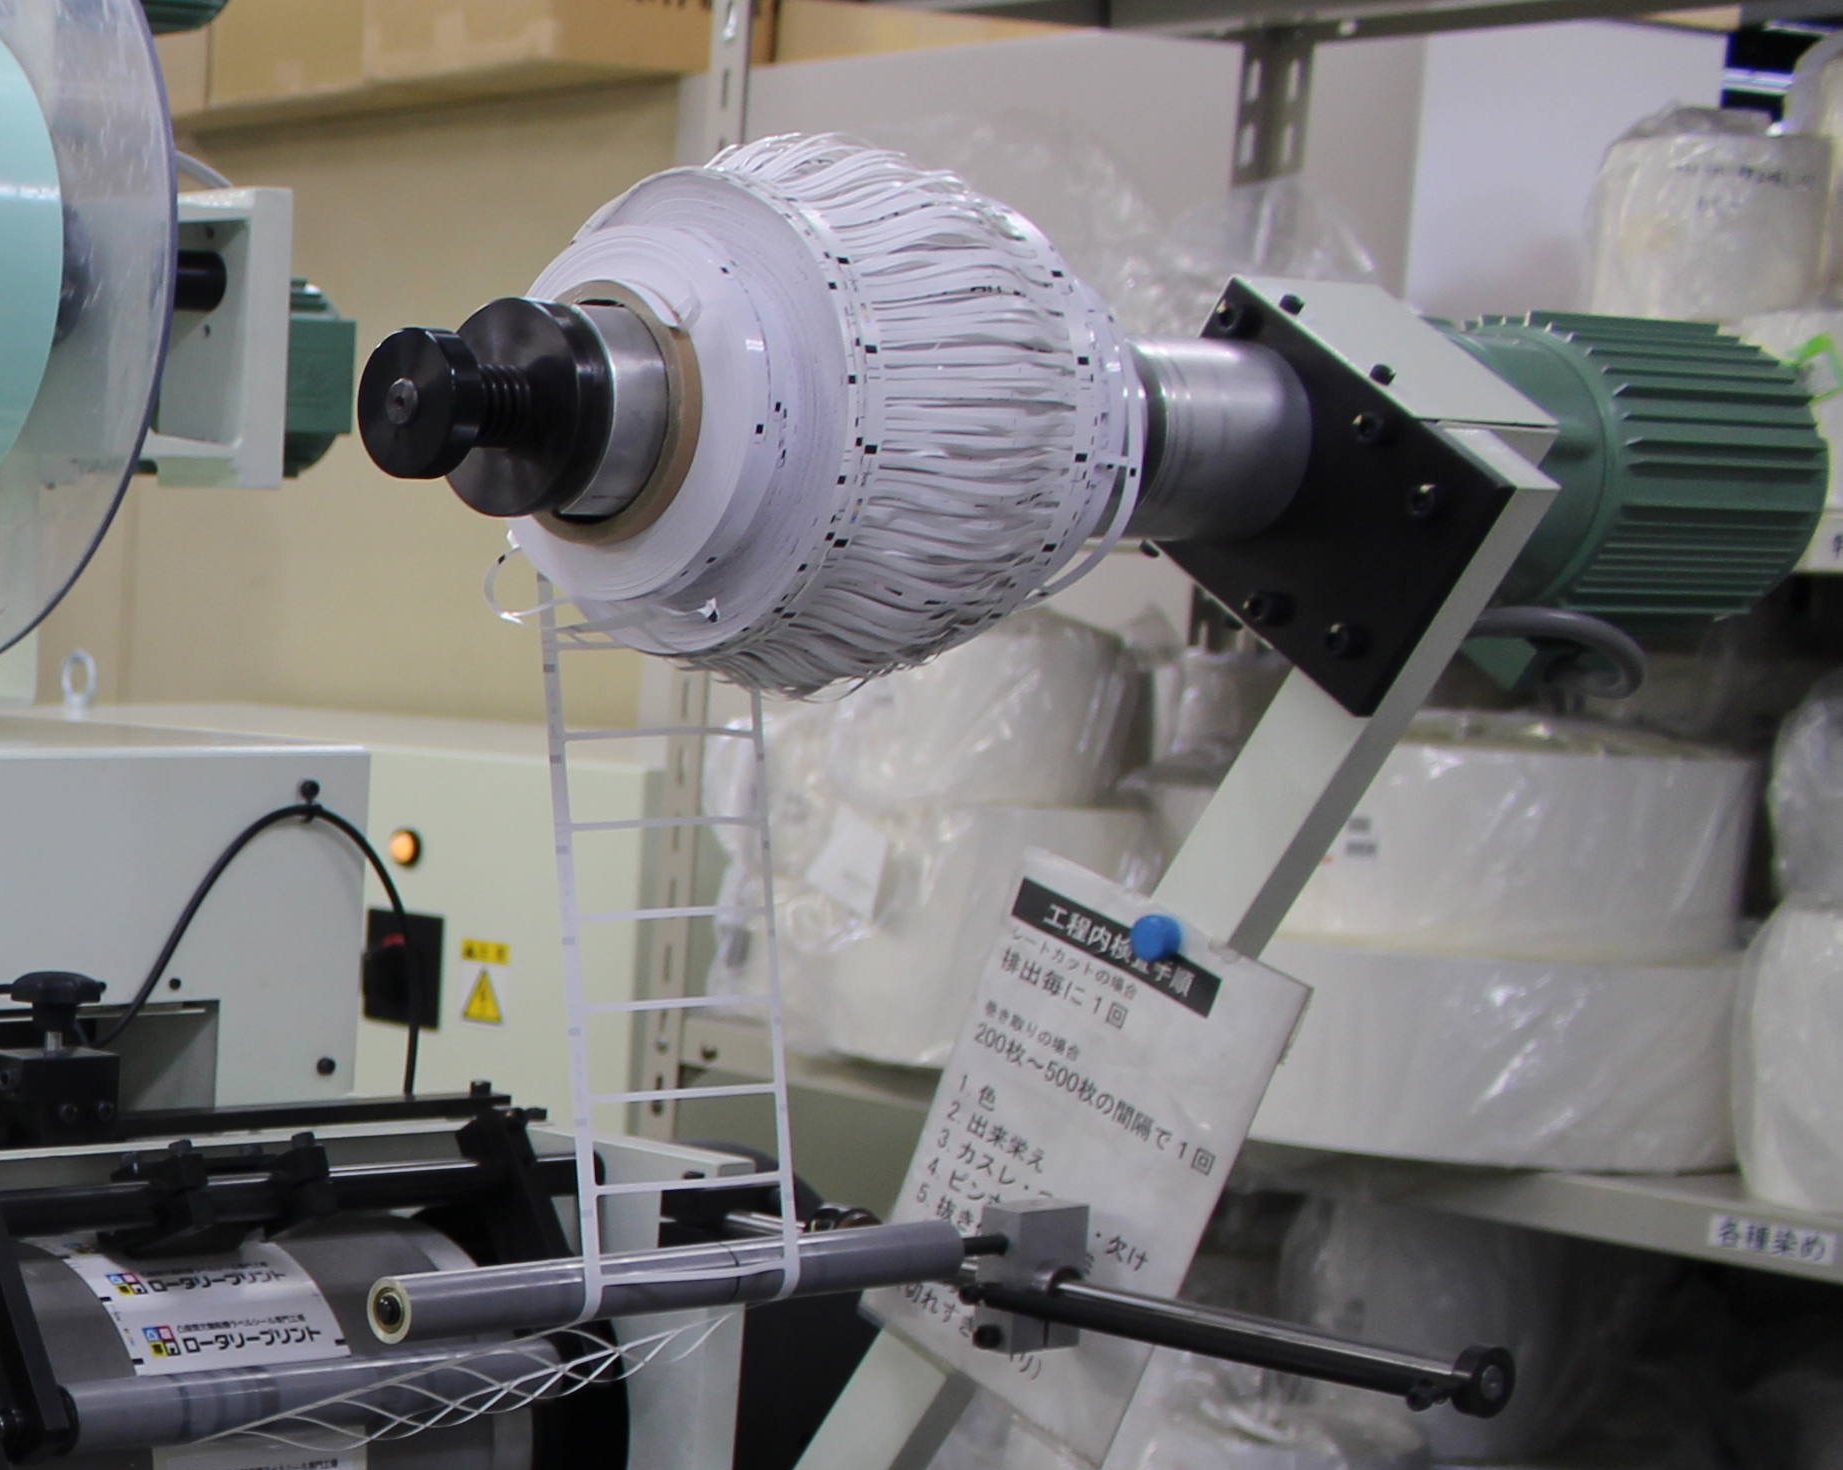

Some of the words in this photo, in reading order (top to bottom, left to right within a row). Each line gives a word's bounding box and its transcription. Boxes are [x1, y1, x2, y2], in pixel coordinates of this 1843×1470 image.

[1012, 927, 1139, 1000] シートカットの場合
[984, 1000, 1082, 1062] 巻き取りの場合
[182, 1326, 321, 1354] ロータリープリント
